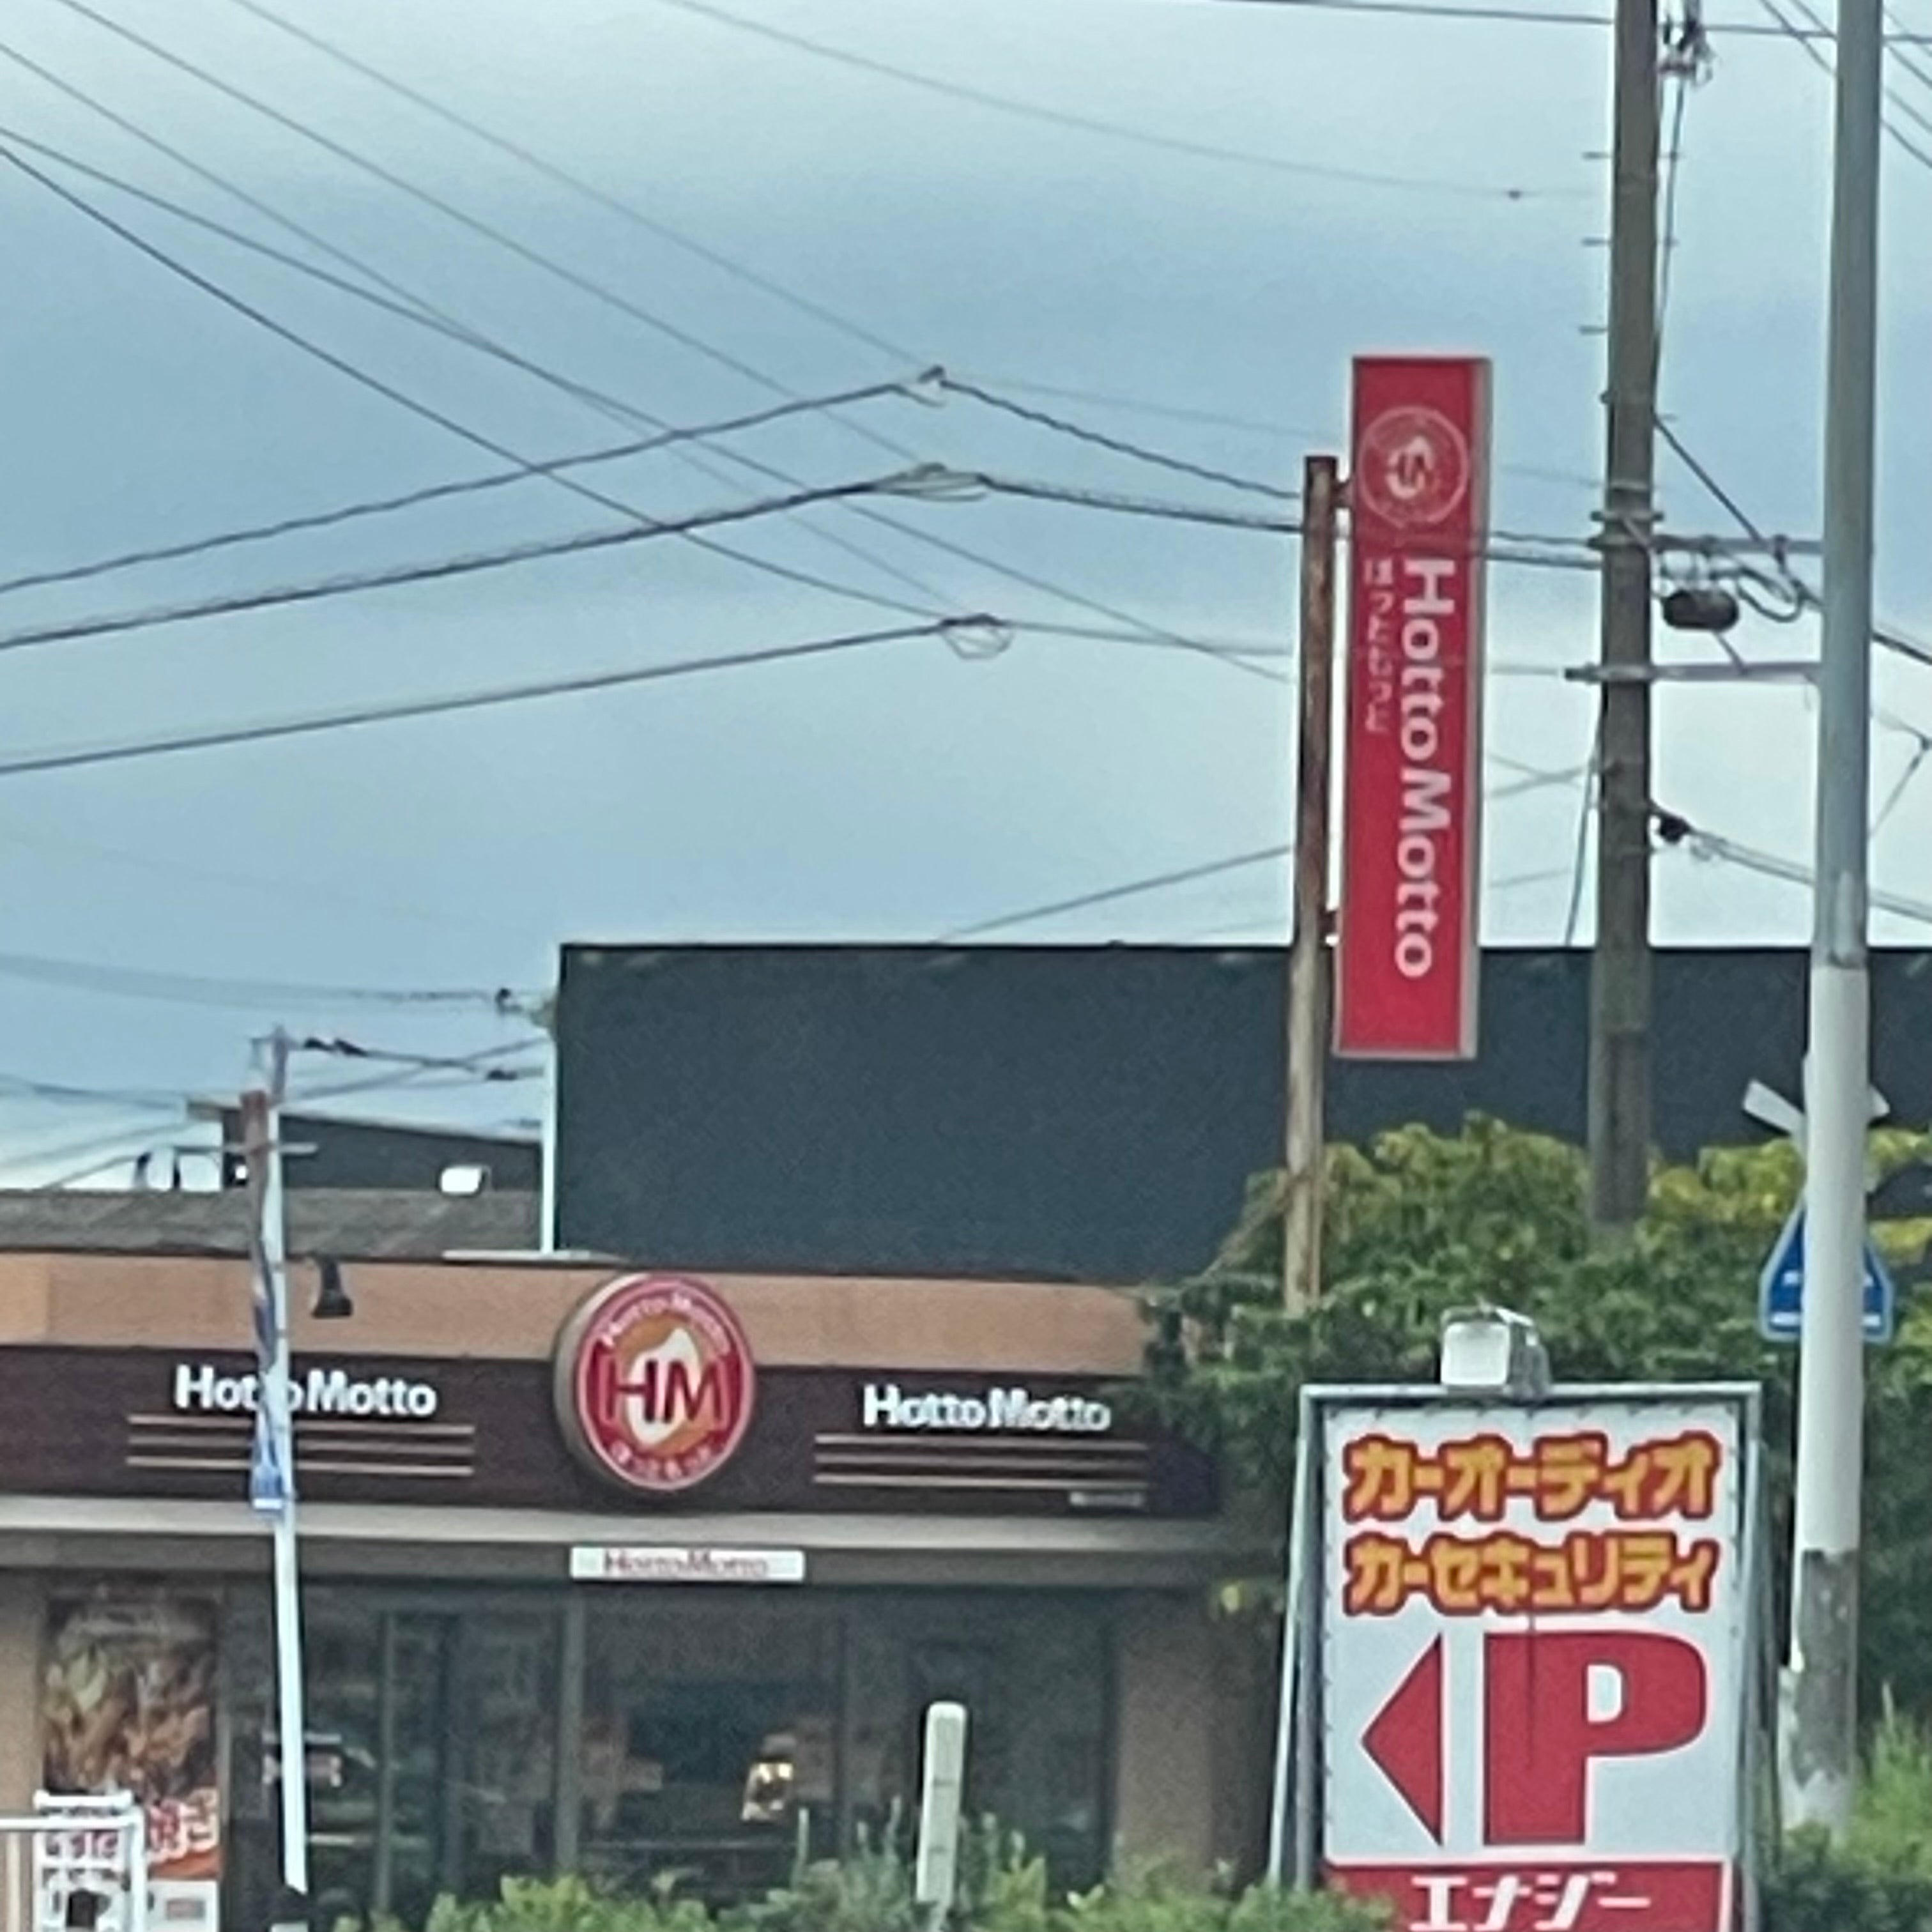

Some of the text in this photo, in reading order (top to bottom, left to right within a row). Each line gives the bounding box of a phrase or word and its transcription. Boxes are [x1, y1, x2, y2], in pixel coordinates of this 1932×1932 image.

[602, 1358, 726, 1425] HM
[1343, 1431, 1721, 1521] カーオーディオ
[1343, 1531, 1721, 1616] カーセキュリティ
[1483, 1631, 1706, 1845] P
[1409, 1872, 1651, 1932] エナジー
